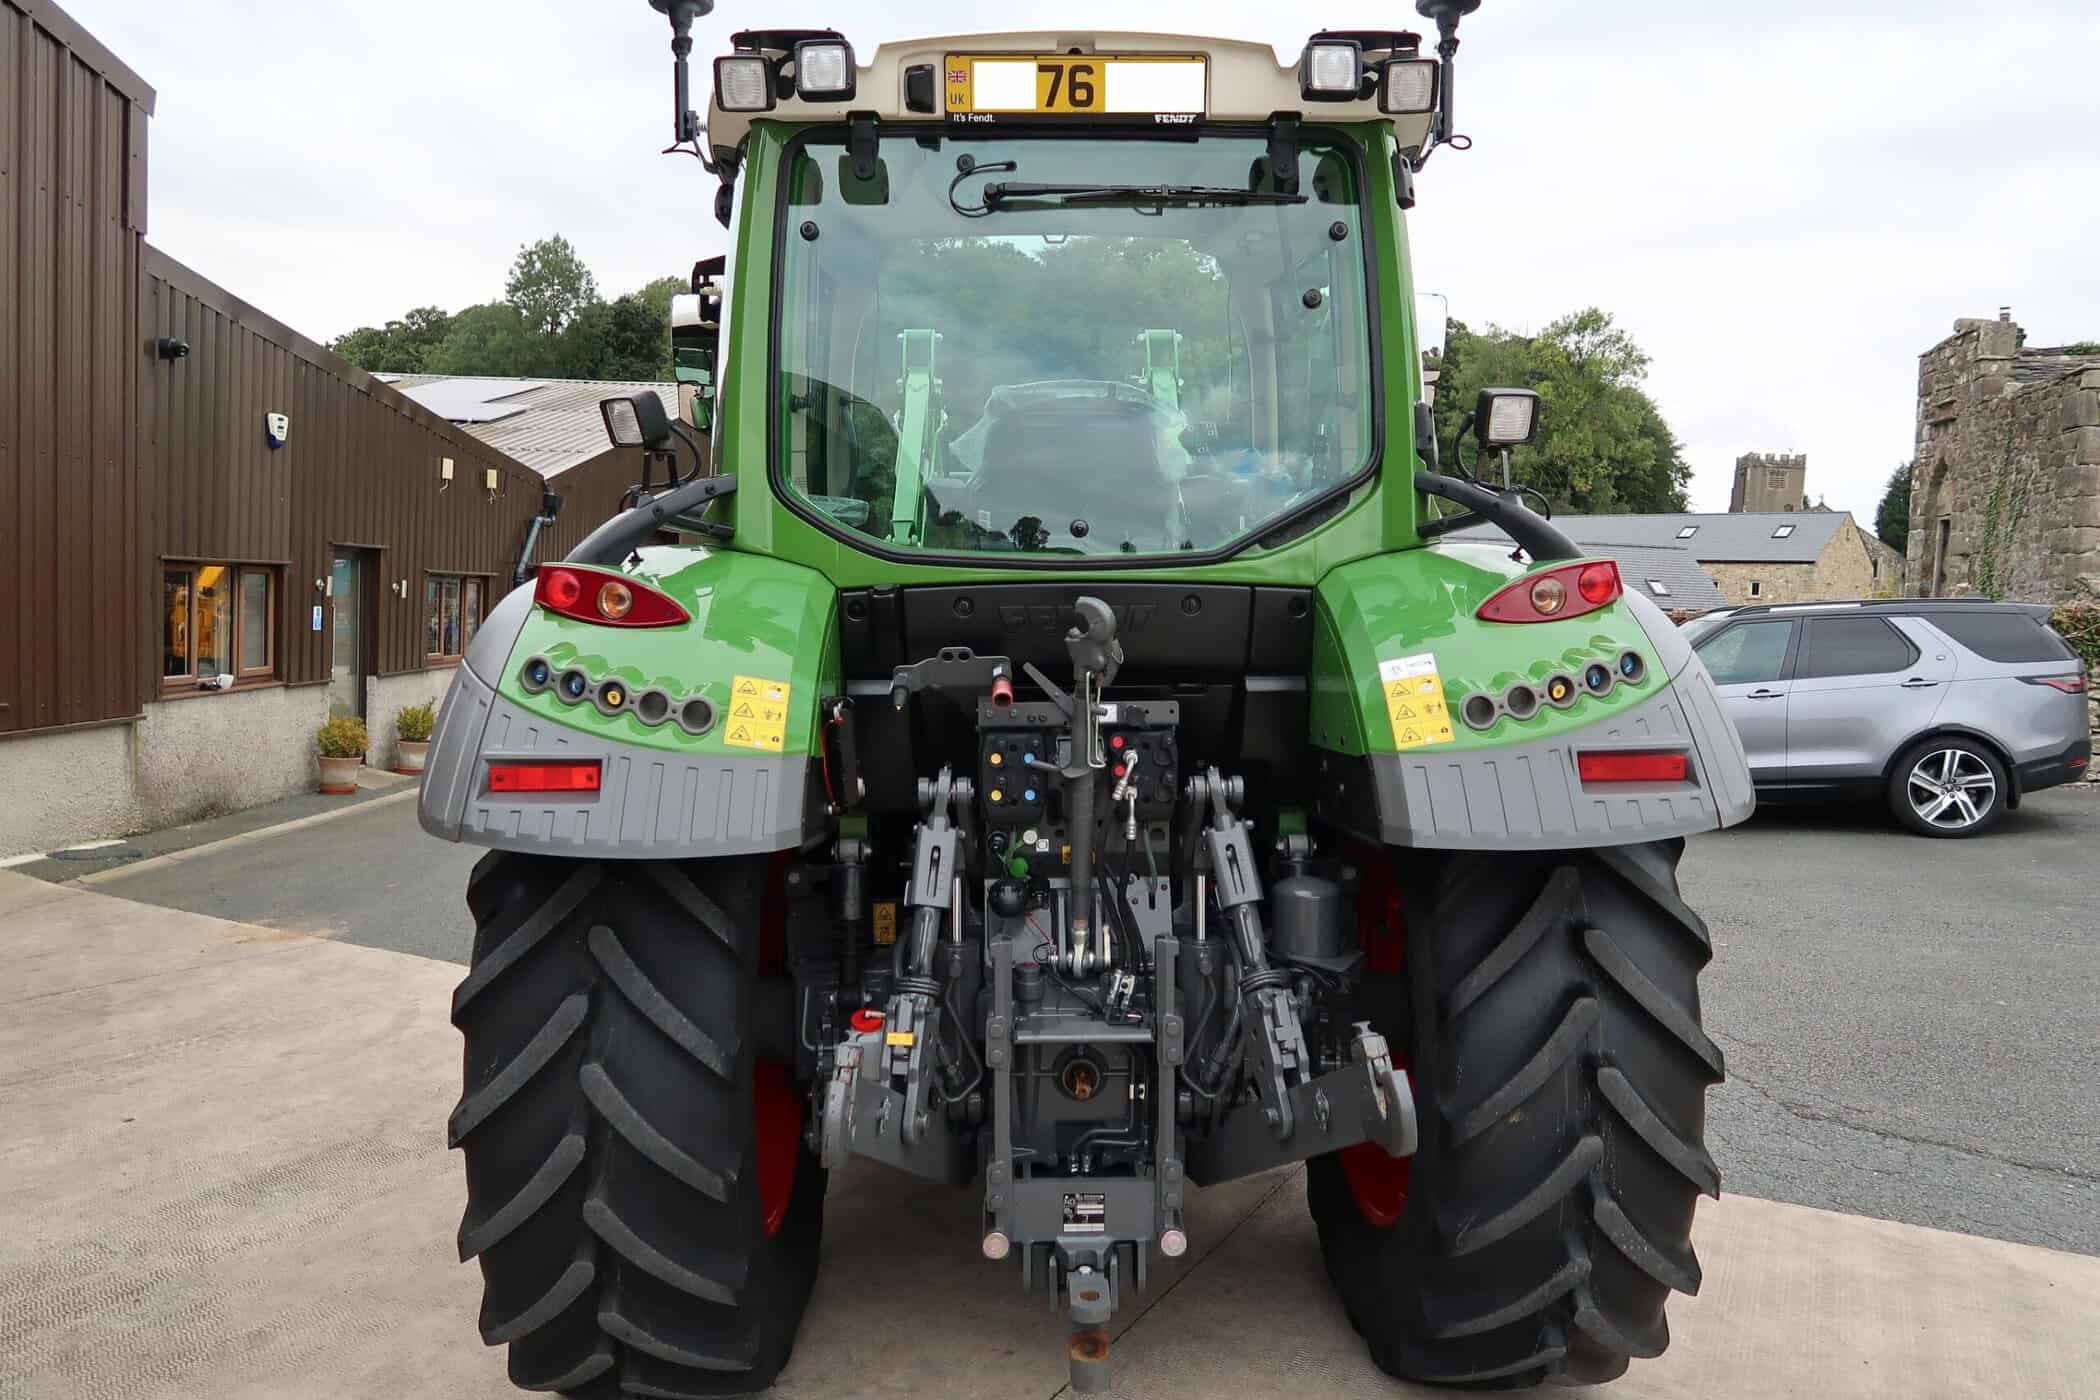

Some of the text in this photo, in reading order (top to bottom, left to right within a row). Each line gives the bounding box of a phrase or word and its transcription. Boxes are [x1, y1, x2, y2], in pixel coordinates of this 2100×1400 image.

[1038, 65, 1094, 108] 76
[950, 94, 965, 105] UK
[953, 113, 996, 123] It's Fendt.
[1154, 114, 1196, 124] FENDT
